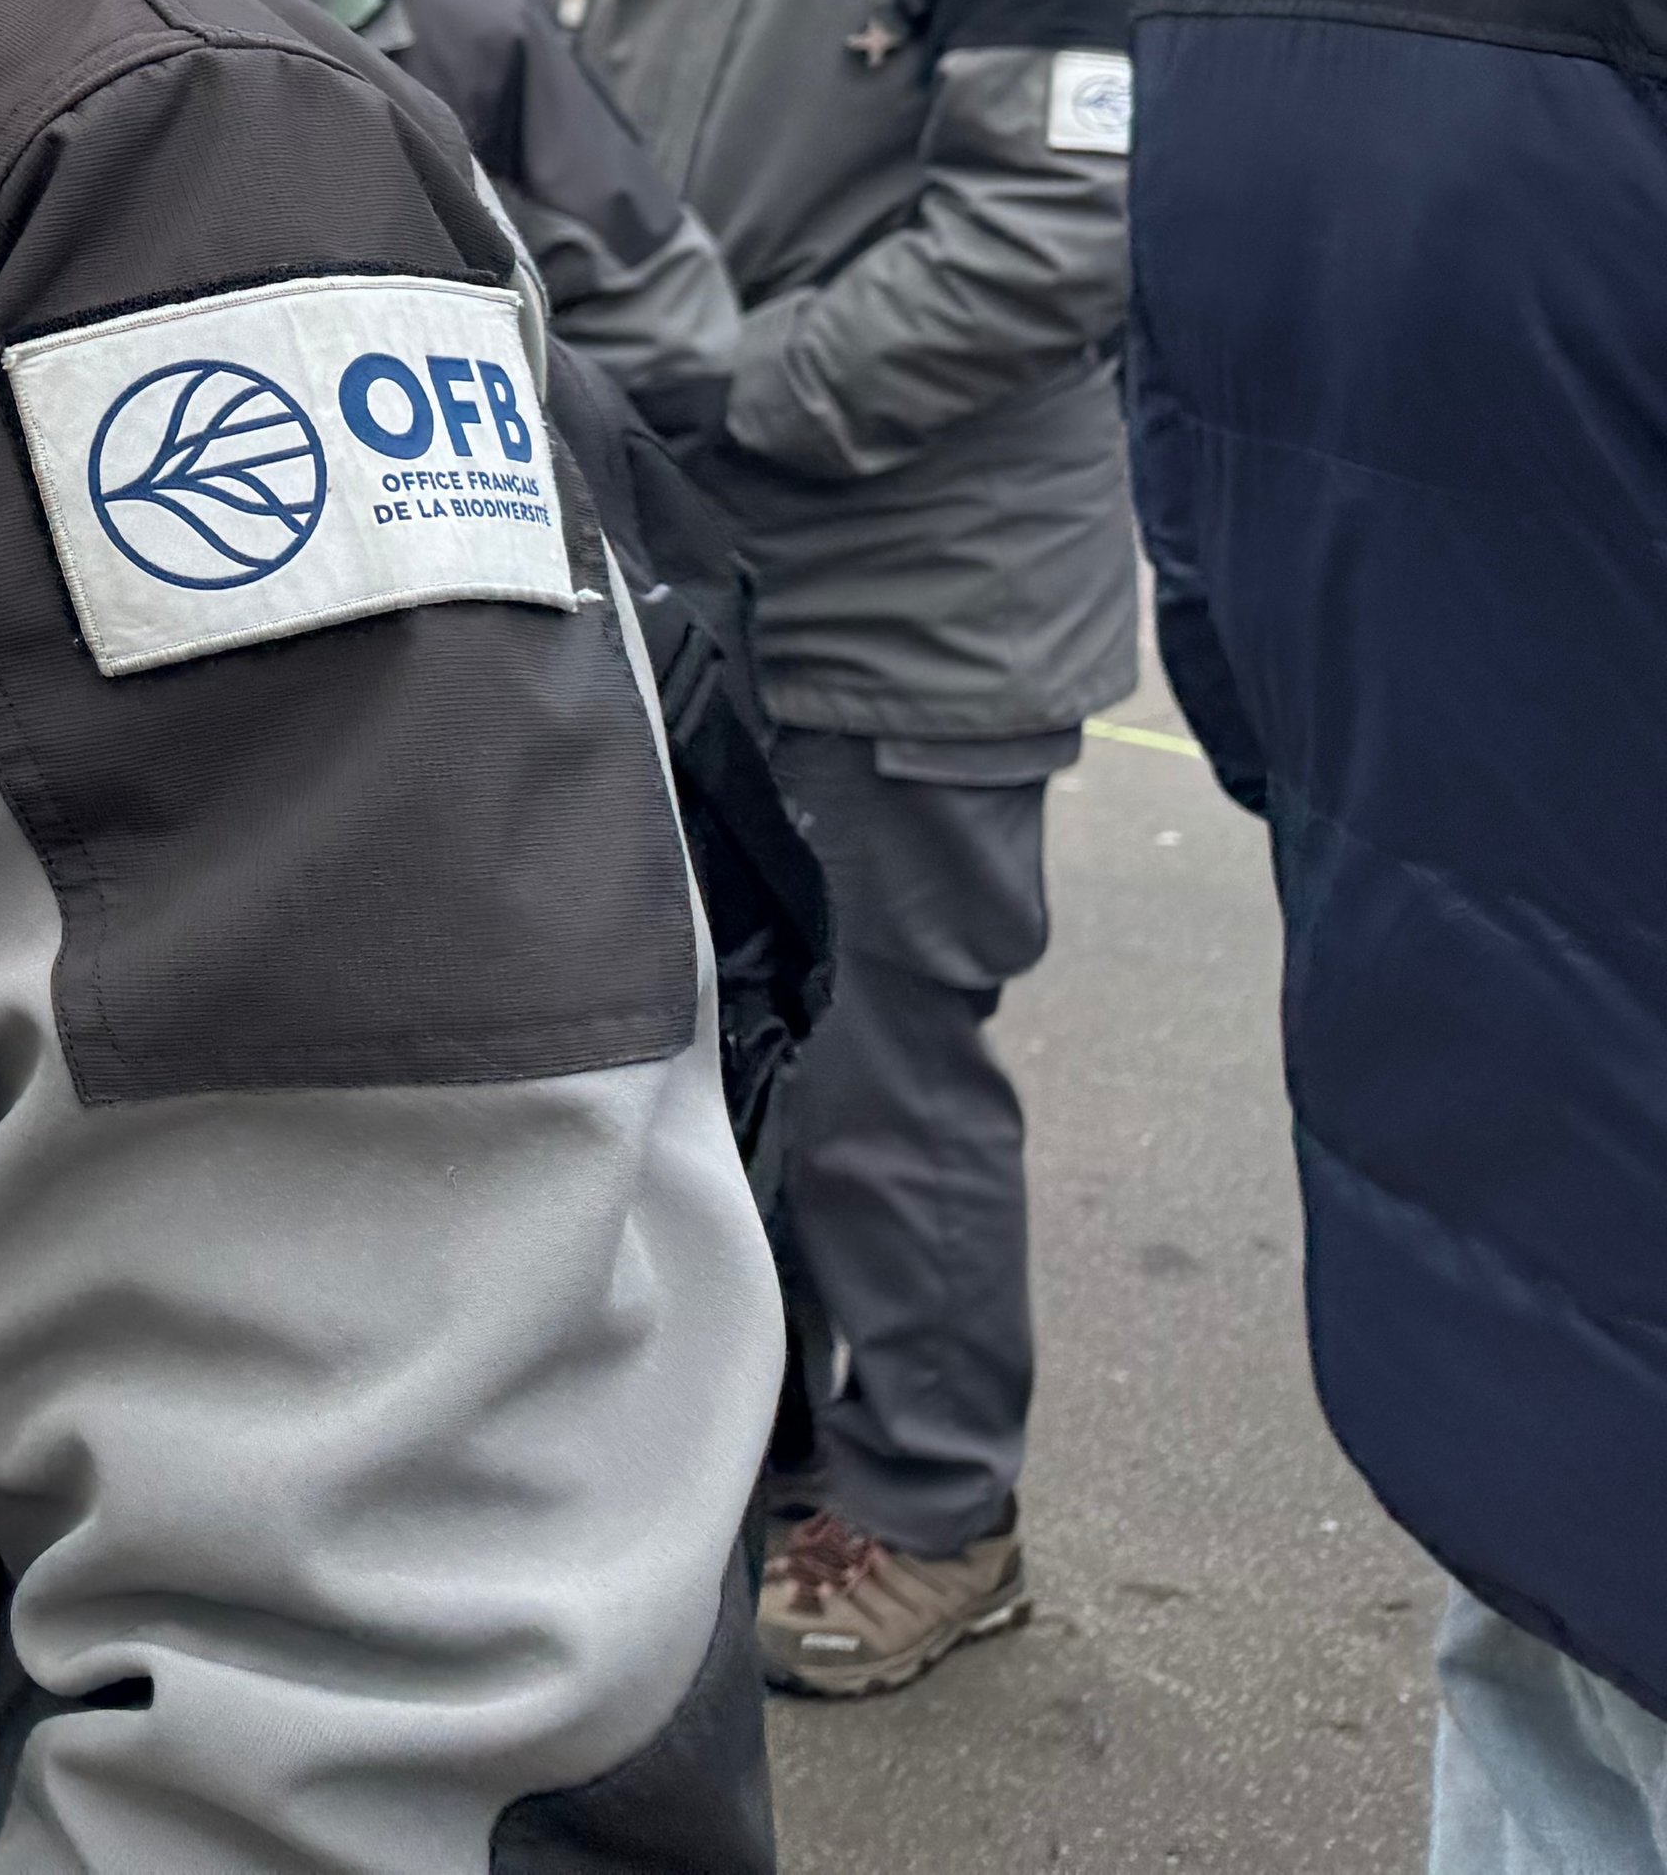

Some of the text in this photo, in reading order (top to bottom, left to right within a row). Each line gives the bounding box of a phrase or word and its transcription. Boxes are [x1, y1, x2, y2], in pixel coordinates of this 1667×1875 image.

[337, 351, 533, 465] OFB
[381, 470, 540, 497] OFFICE FRANÇAIS
[372, 498, 553, 527] DE LA BIODIVERSITÉ
